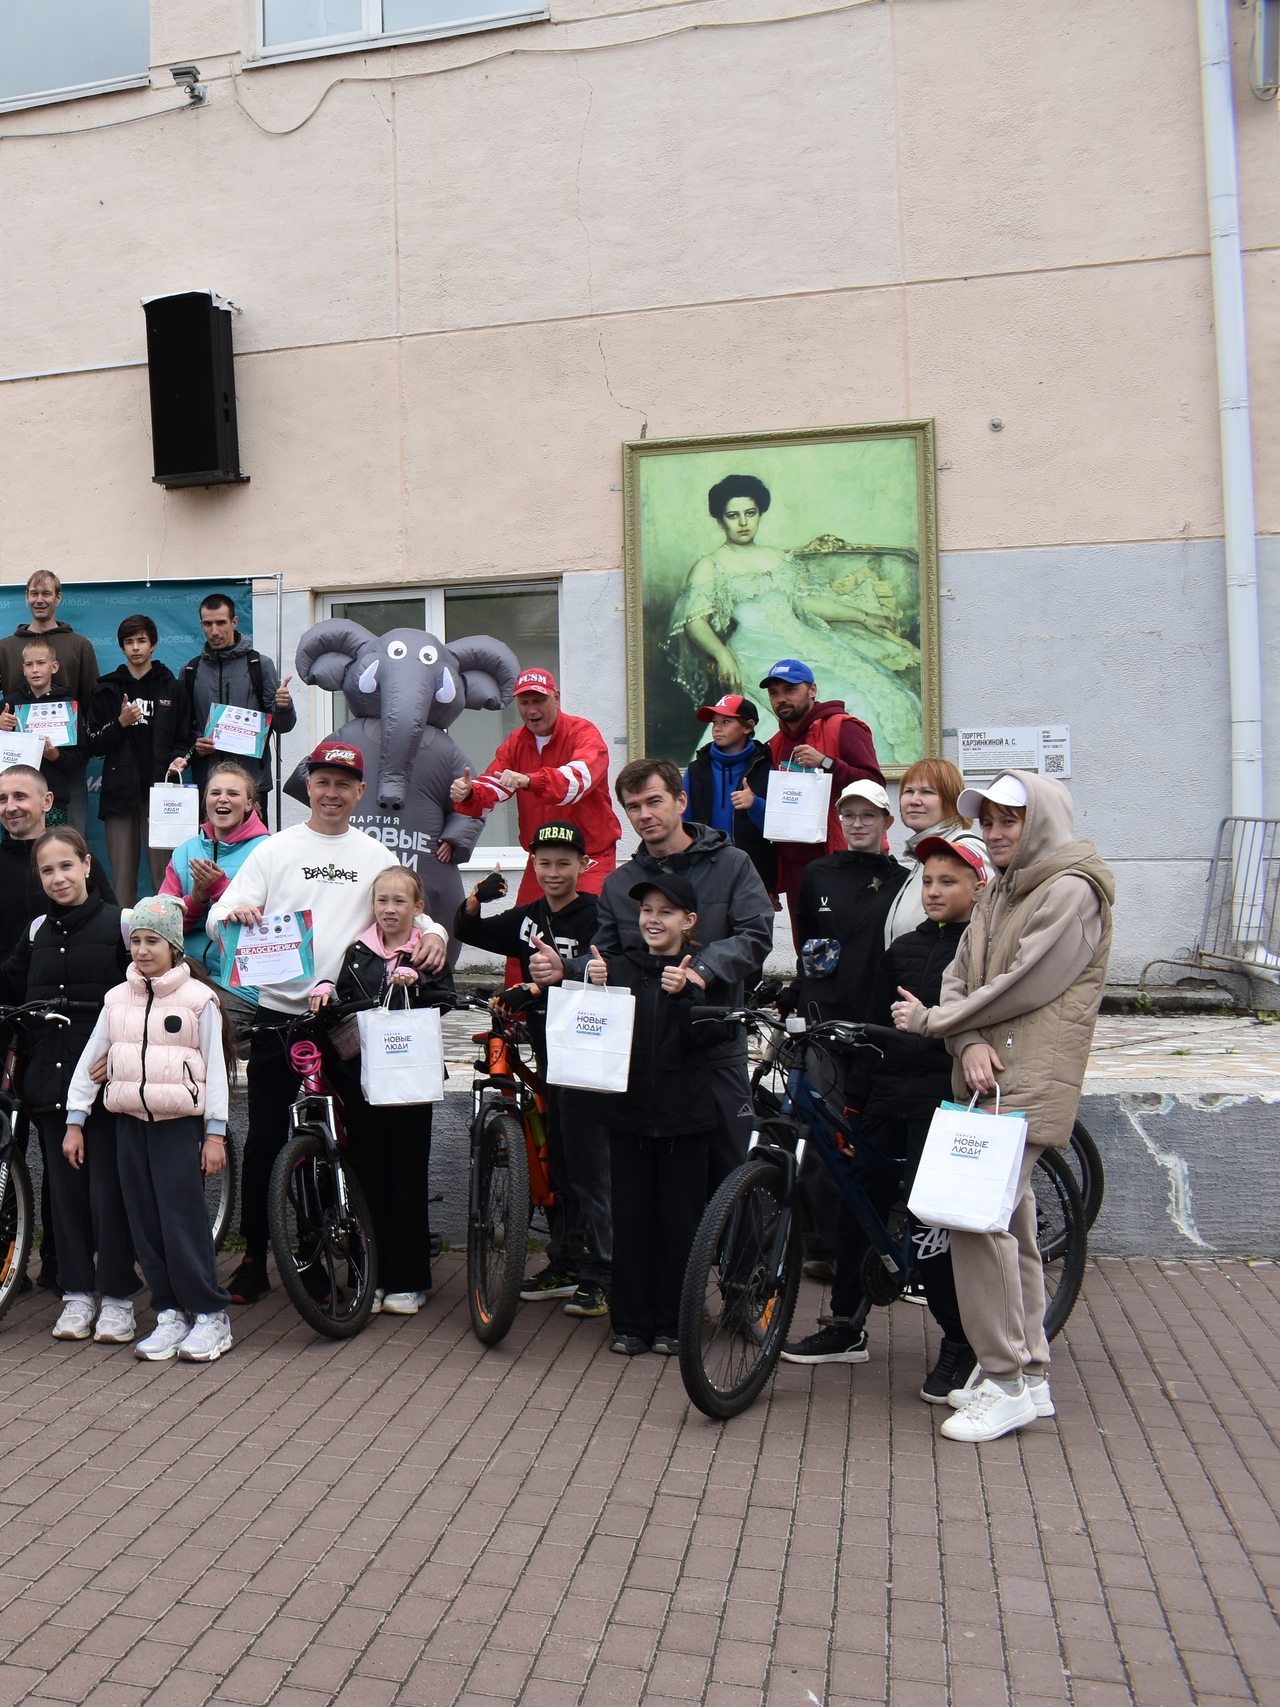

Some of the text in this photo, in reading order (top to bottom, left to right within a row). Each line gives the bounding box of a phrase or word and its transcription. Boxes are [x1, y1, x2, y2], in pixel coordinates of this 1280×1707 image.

[105, 595, 170, 605] НОВЫЕ ЛЮДИ
[160, 636, 194, 644] НОВЫЕ
[518, 674, 547, 685] FCSM
[962, 738, 1003, 746] КАРЗИНКИНОЙ
[349, 815, 400, 825] ПАРТИЯ
[539, 827, 574, 841] URBAN
[359, 826, 431, 853] ОВЫЕ
[577, 1015, 607, 1025] НОВЫЕ
[576, 1023, 602, 1032] ЛЮДИ
[384, 1035, 412, 1043] НОВЫЕ
[953, 1137, 989, 1149] НОВЫЕ
[951, 1145, 981, 1155] ЛЮДИ
